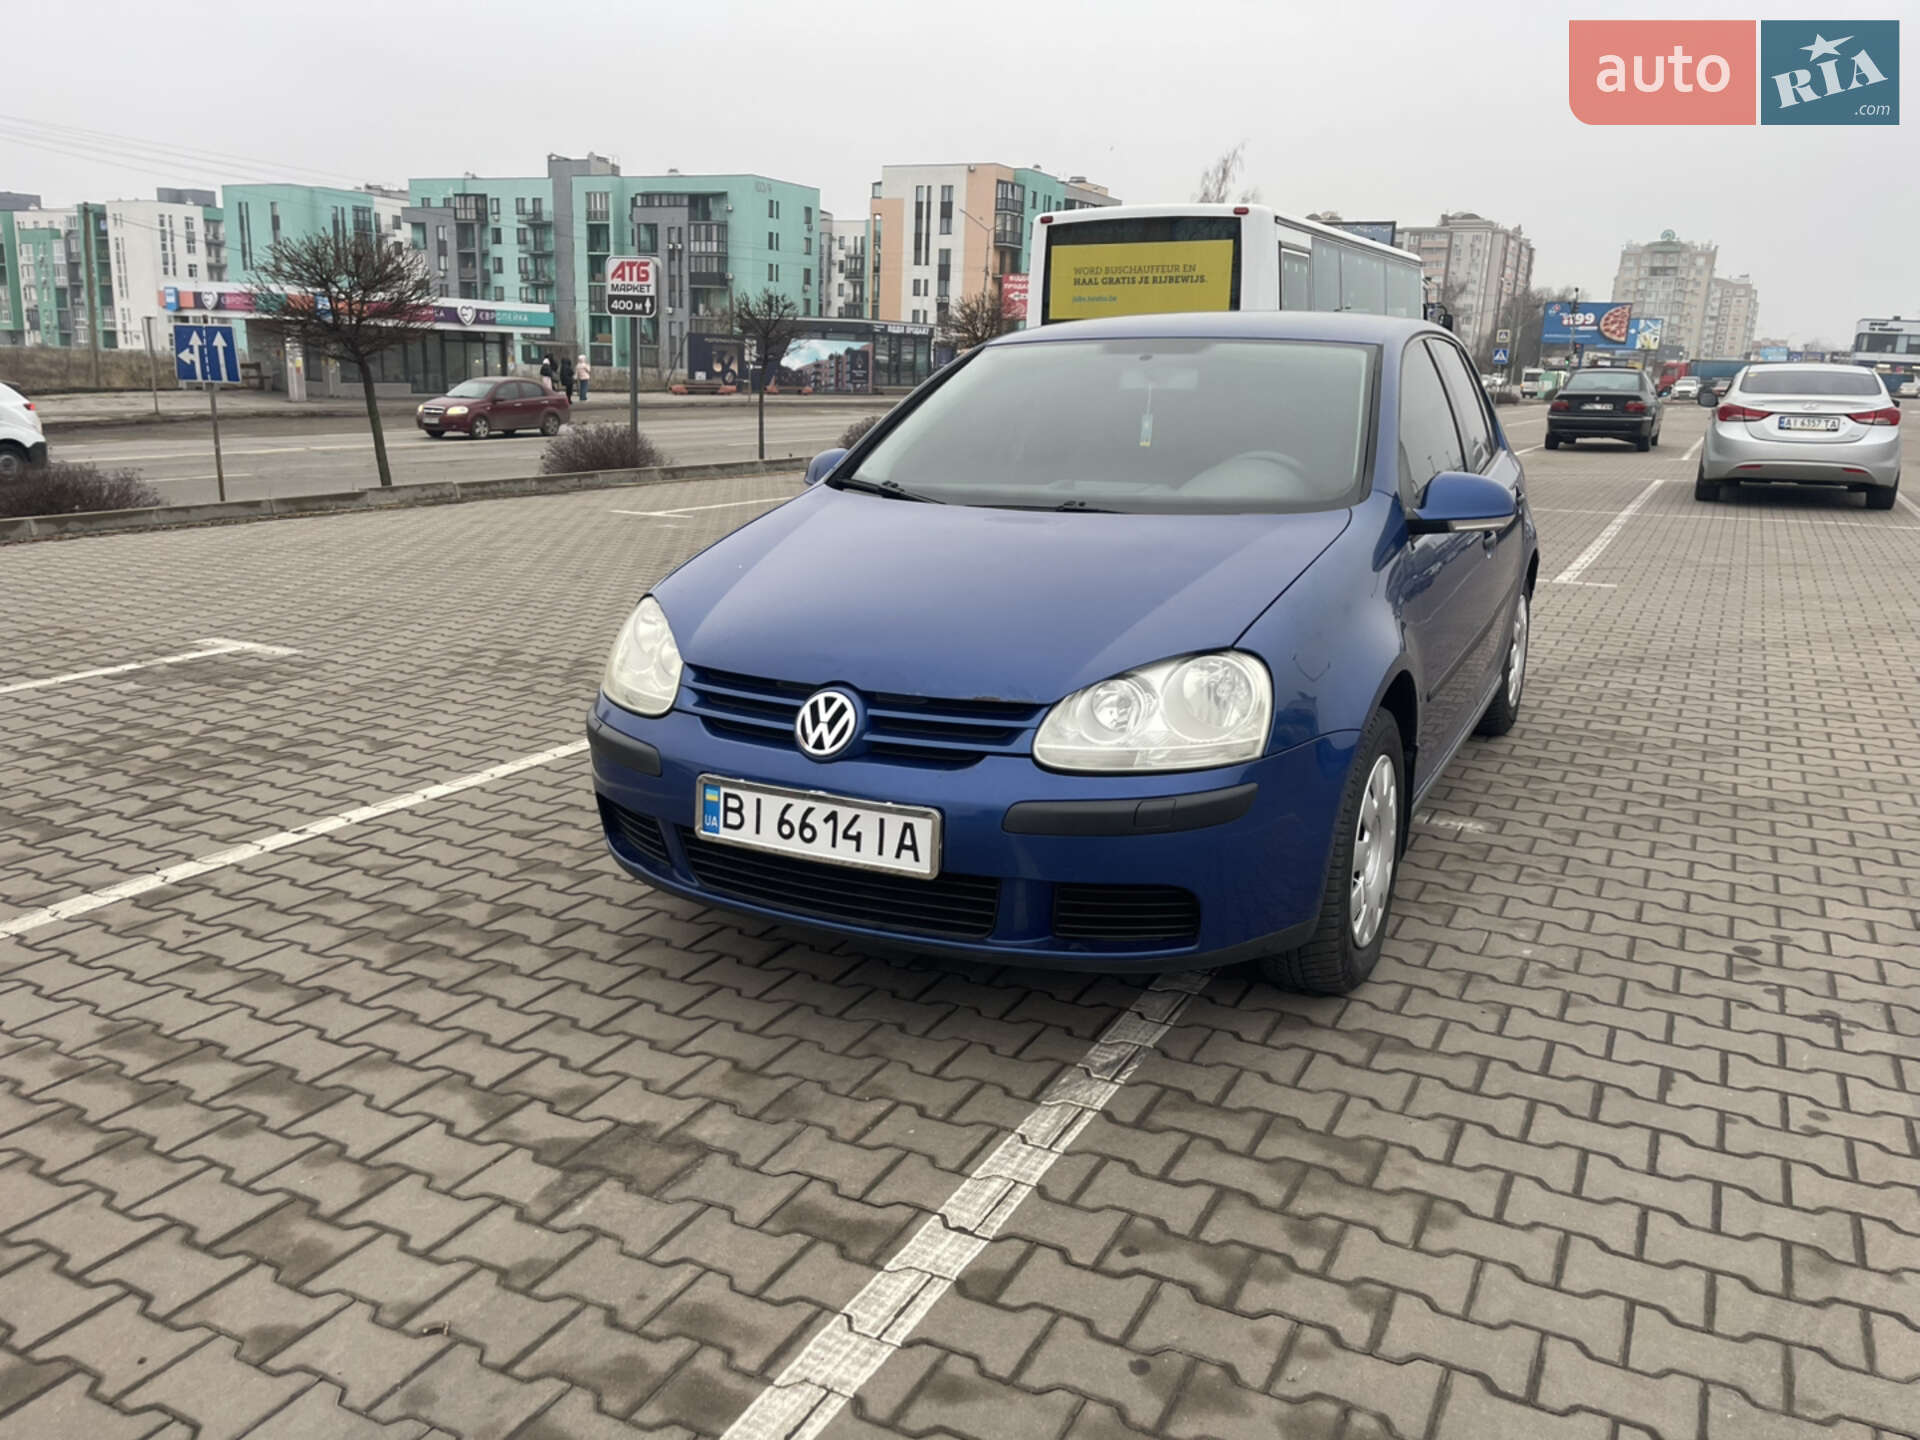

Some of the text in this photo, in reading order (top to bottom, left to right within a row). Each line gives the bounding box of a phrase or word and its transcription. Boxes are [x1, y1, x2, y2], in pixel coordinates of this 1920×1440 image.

[611, 261, 650, 282] АТБ
[1073, 263, 1197, 275] WORD BUSCHAUFFEUR EN
[1073, 277, 1099, 286] HAAL
[1101, 276, 1136, 286] GRATIS
[1138, 275, 1150, 285] JE
[611, 284, 651, 293] МАРКЕТ
[611, 299, 633, 310] 400
[704, 815, 718, 828] UA
[722, 792, 920, 863] BI 6614 IA
